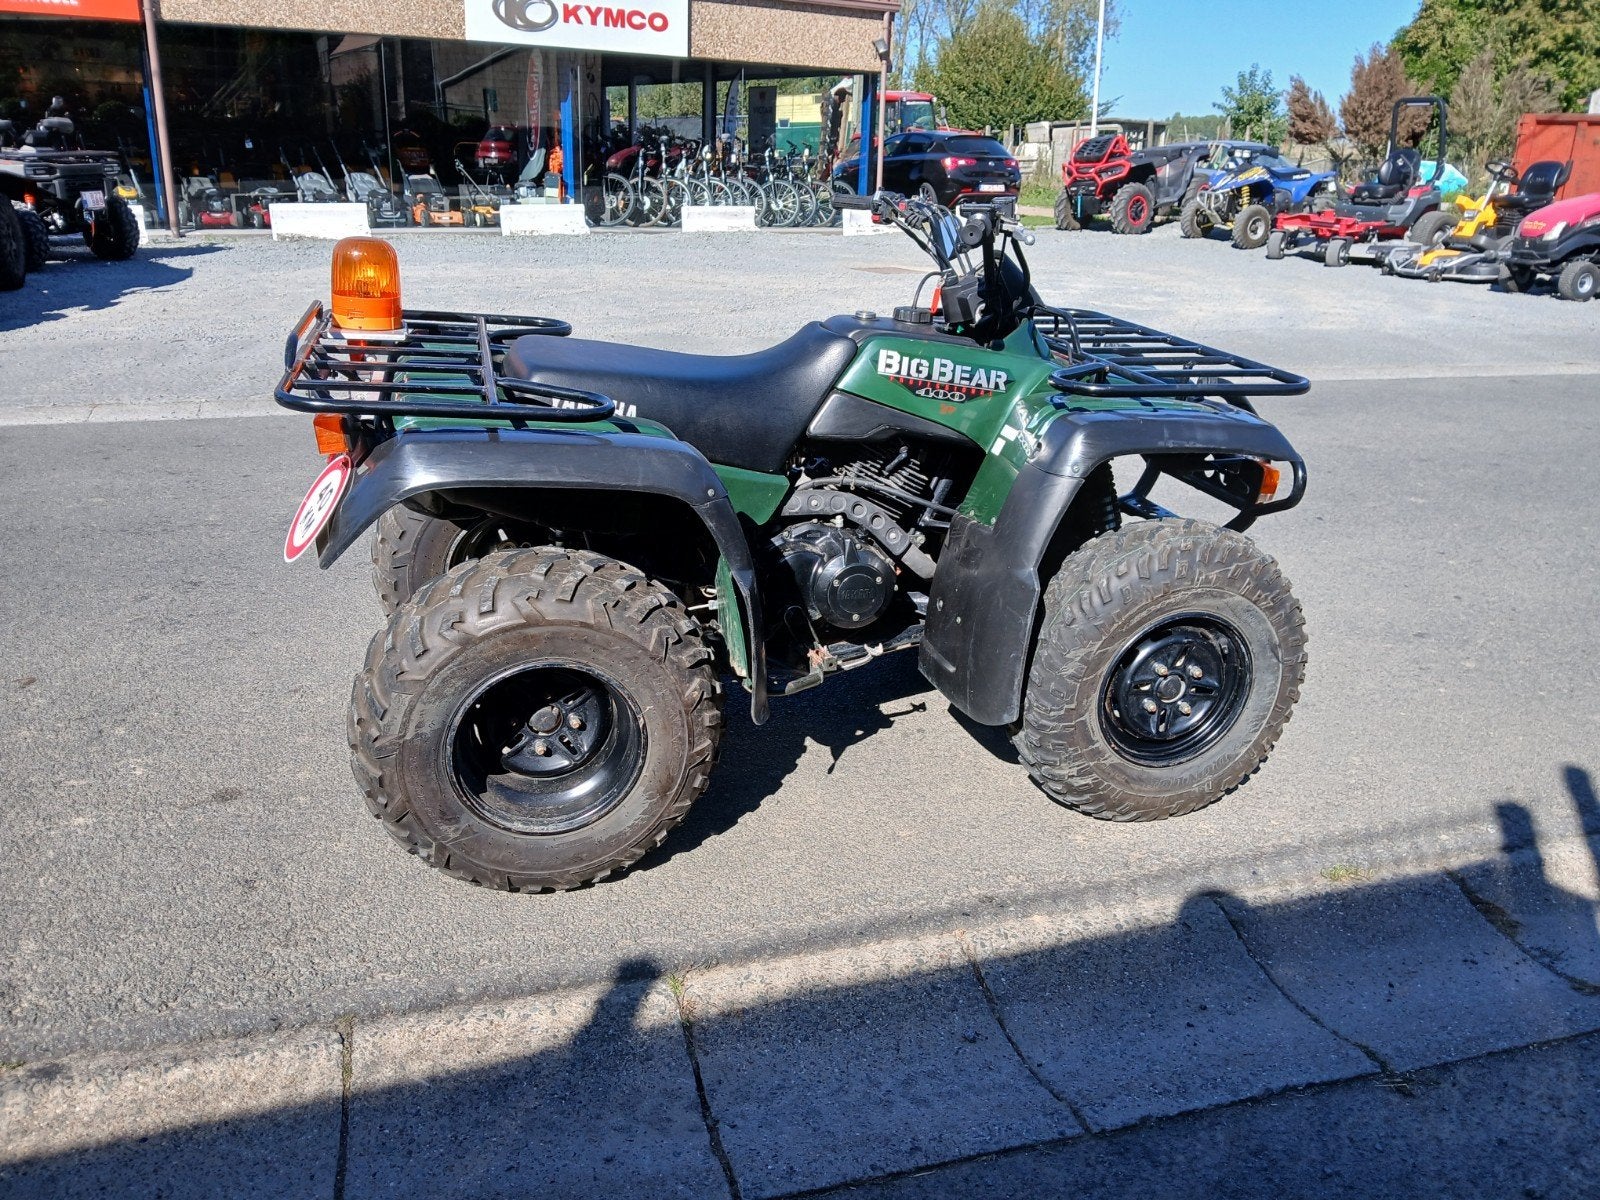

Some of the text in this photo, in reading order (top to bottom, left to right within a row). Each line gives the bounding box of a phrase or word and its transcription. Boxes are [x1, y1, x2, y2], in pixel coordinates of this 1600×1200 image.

[563, 3, 669, 32] KYMCO
[877, 349, 1008, 391] BIG BEAR
[317, 482, 333, 512] 40
